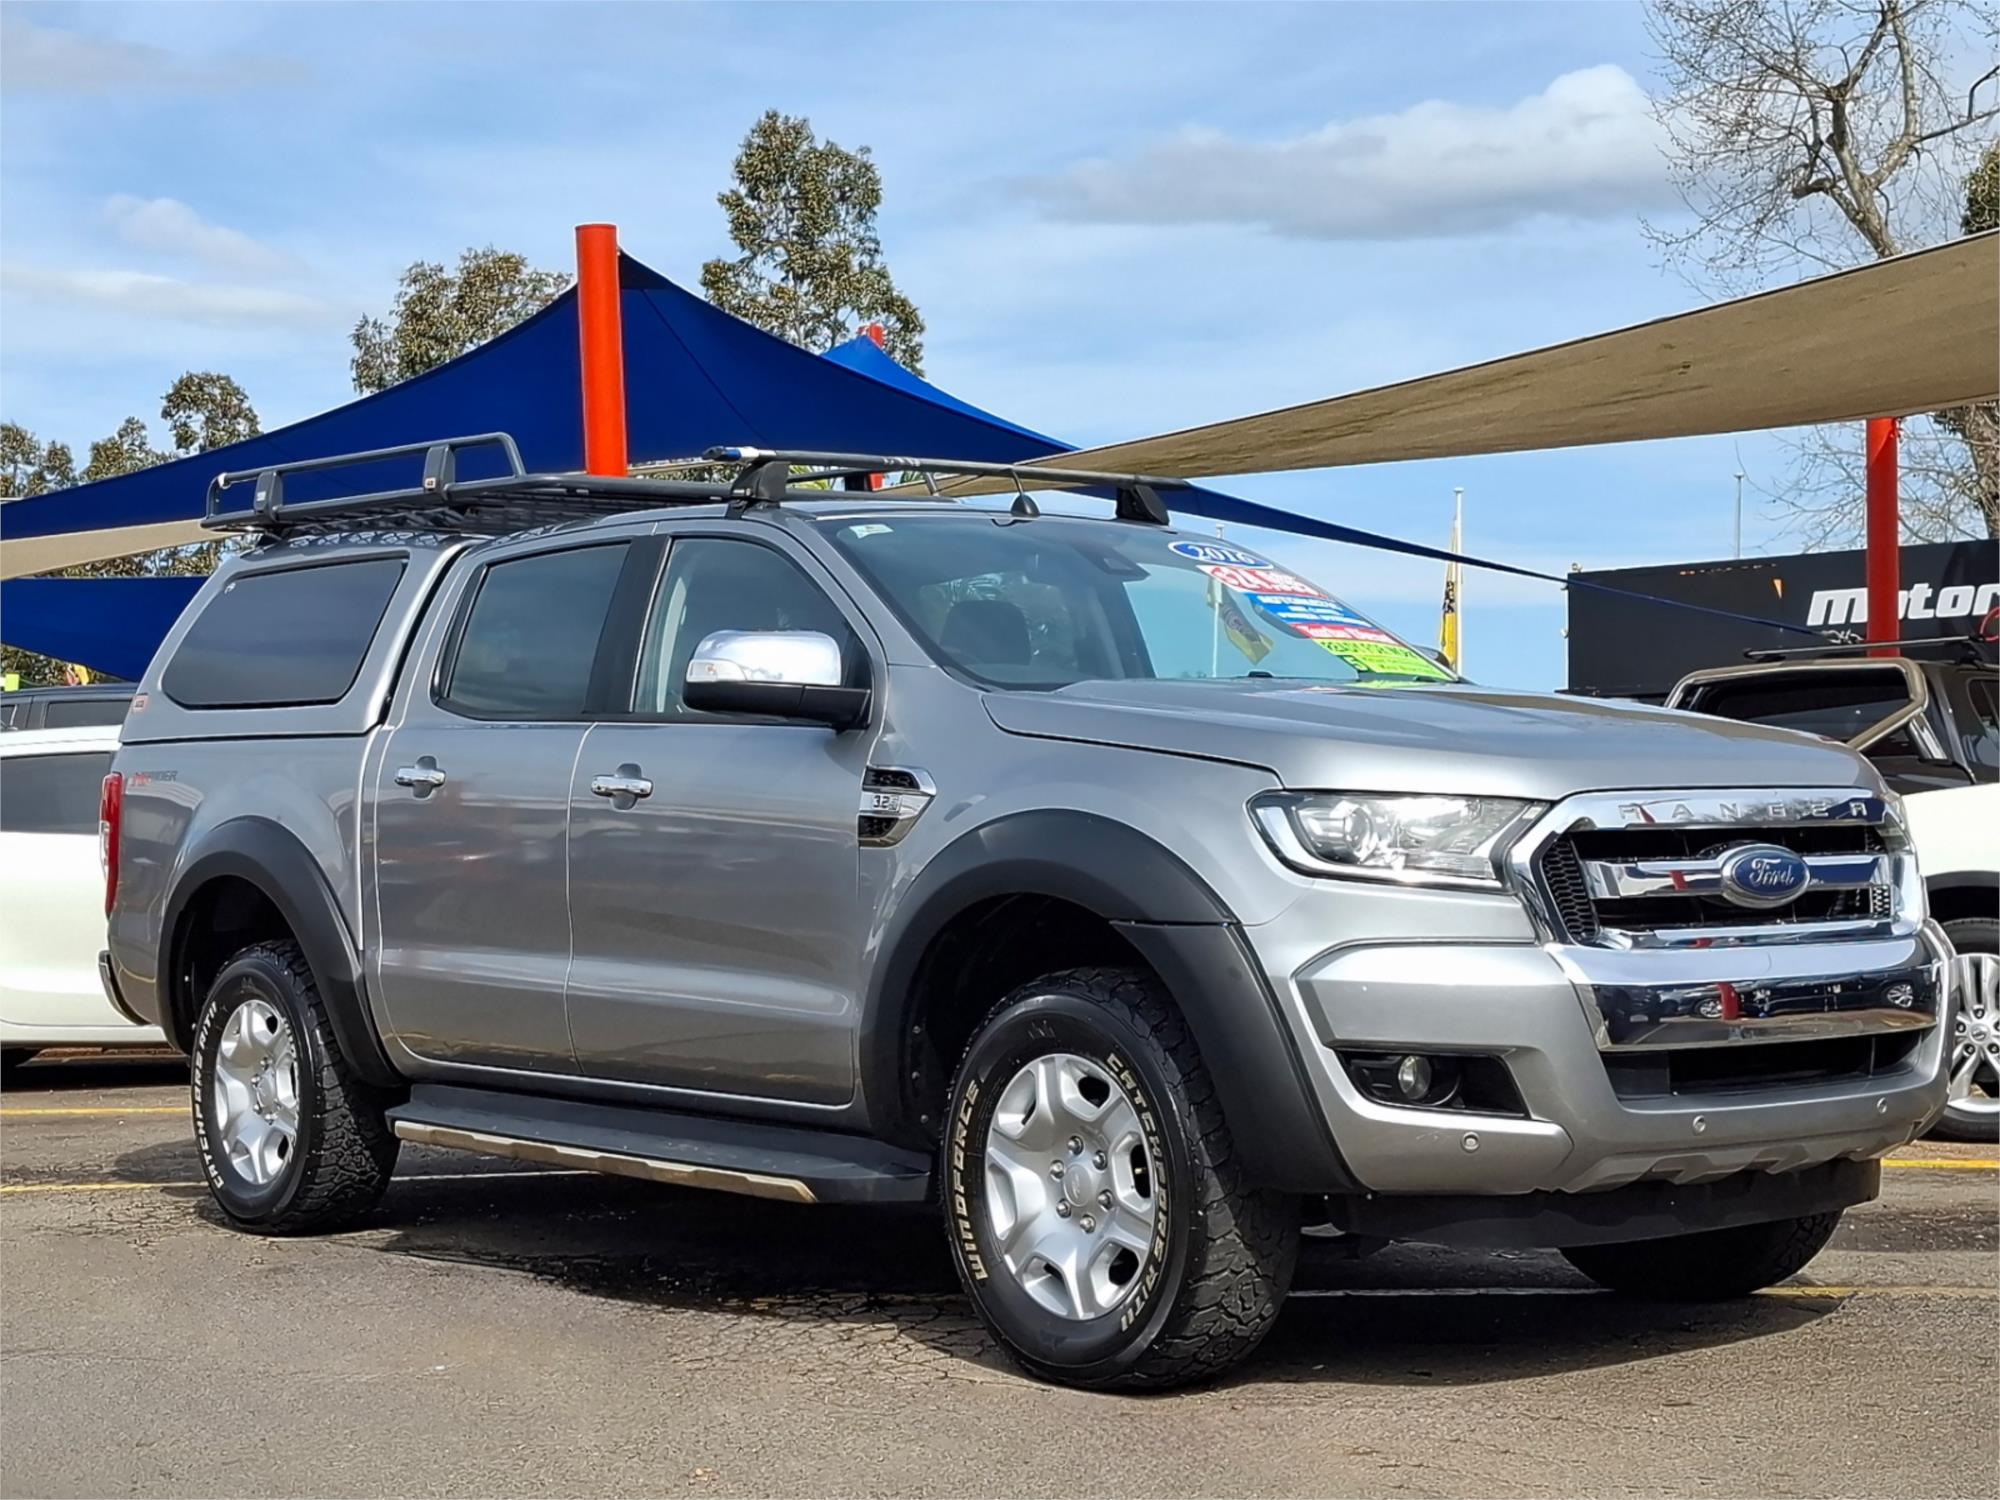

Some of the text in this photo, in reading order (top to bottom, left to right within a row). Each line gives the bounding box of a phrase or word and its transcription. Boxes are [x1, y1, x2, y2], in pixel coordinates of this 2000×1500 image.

[1188, 545, 1254, 564] 2016
[1807, 583, 2000, 626] mtor
[1618, 802, 1868, 820] RANGER
[1749, 858, 1795, 886] Ford
[953, 1080, 988, 1280] WINDFORCE
